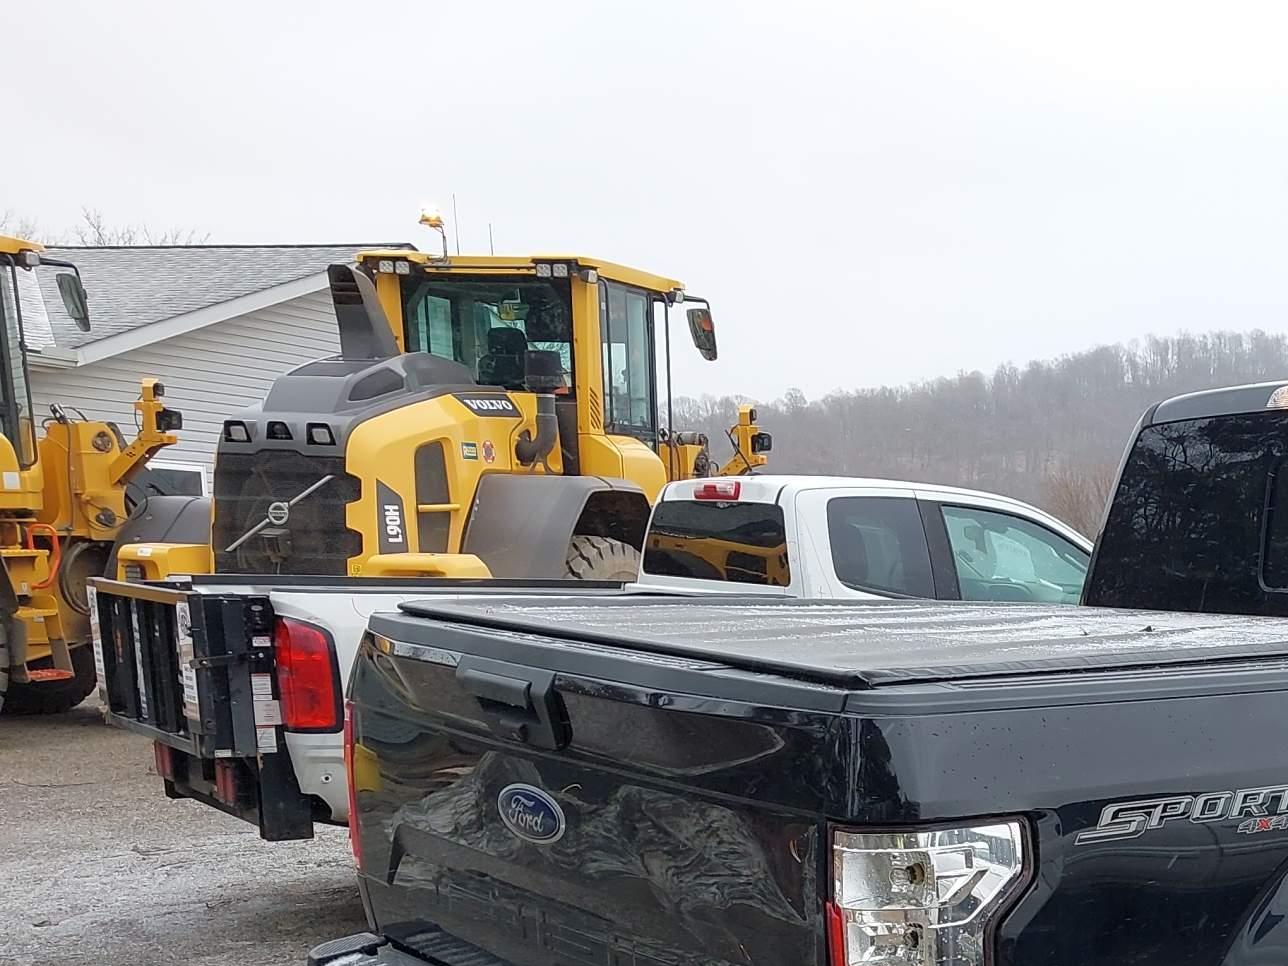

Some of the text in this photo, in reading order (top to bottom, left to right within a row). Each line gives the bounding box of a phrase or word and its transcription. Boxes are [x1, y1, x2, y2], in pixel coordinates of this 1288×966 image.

[464, 399, 513, 410] VOLVO
[384, 504, 403, 543] L90H
[508, 795, 544, 832] Ford
